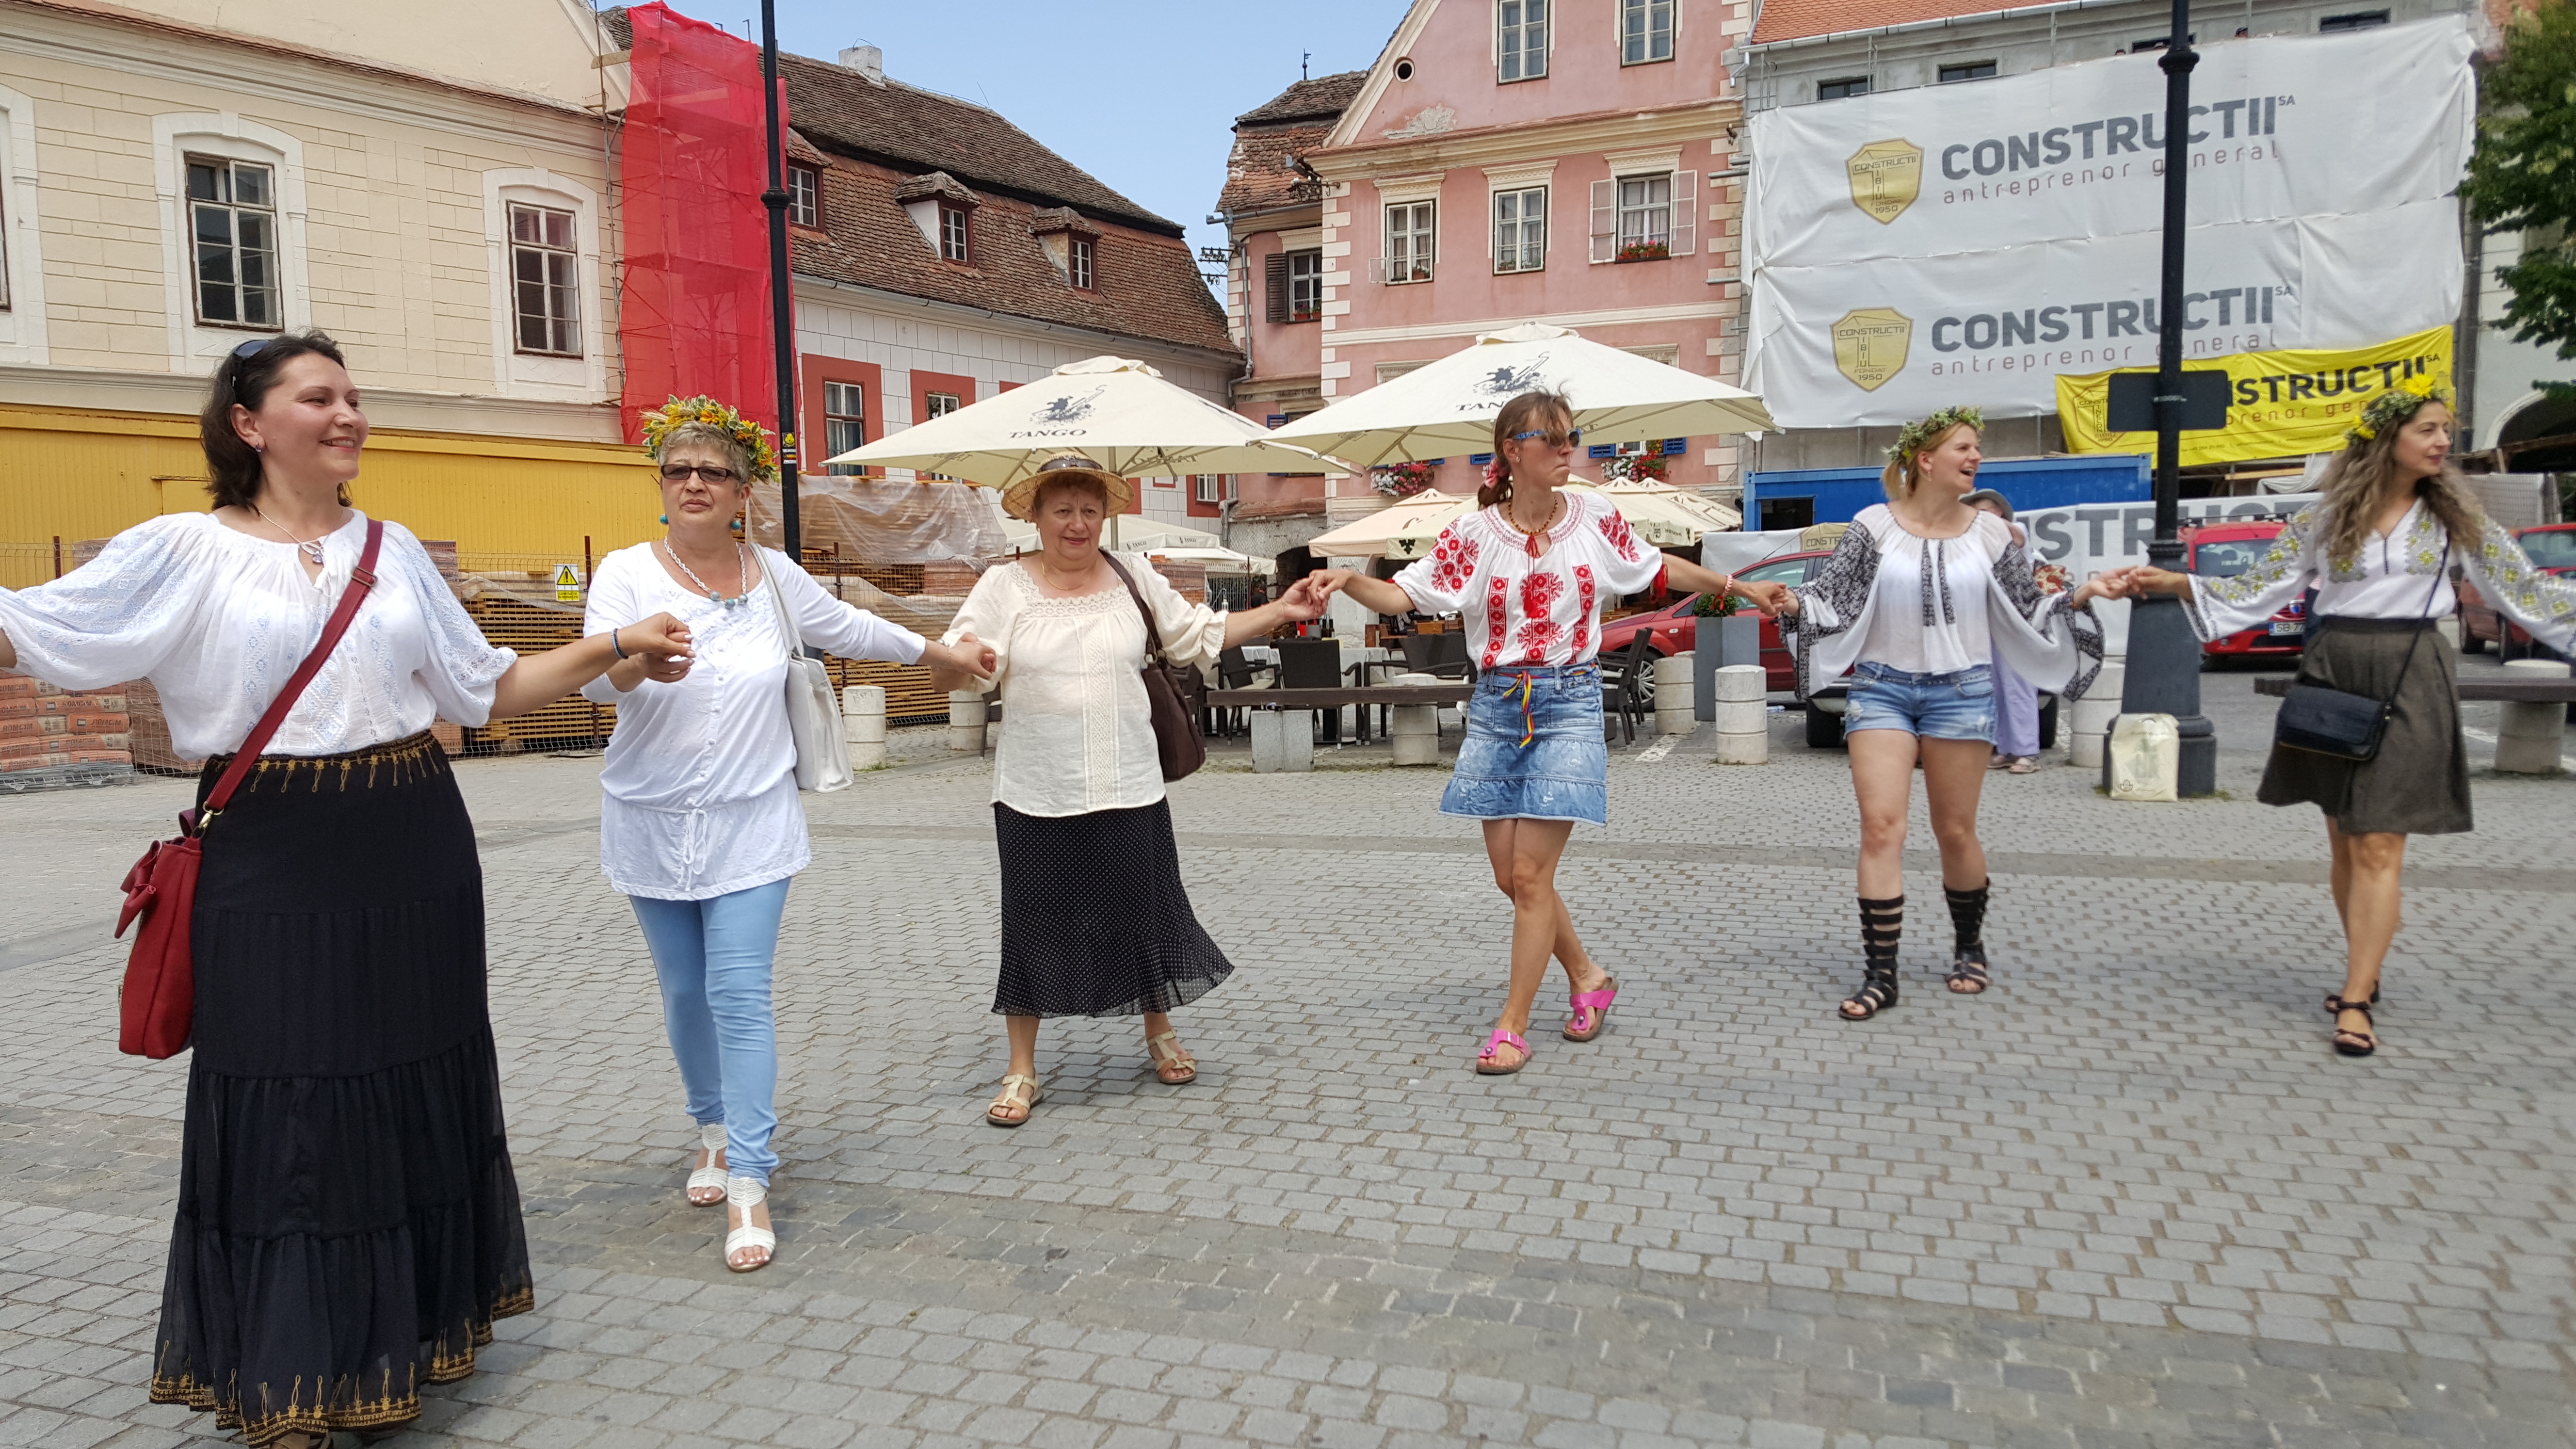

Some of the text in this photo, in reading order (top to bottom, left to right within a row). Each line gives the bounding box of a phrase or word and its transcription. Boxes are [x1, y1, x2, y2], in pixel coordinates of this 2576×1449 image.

[1942, 95, 2296, 180] CONSTRUCTII SA
[1854, 156, 1916, 171] CONSTRUCTII
[1944, 140, 2279, 204] antreprenor gneral
[1875, 205, 1898, 213] 1950
[1932, 286, 2292, 352] CONSTRUCTII SA
[1839, 326, 1904, 337] CONSTRUCTII
[1932, 329, 2276, 375] antreprenor neral
[2426, 353, 2440, 362] SA
[1456, 401, 1505, 411] TAN
[1009, 429, 1087, 438] TANGO
